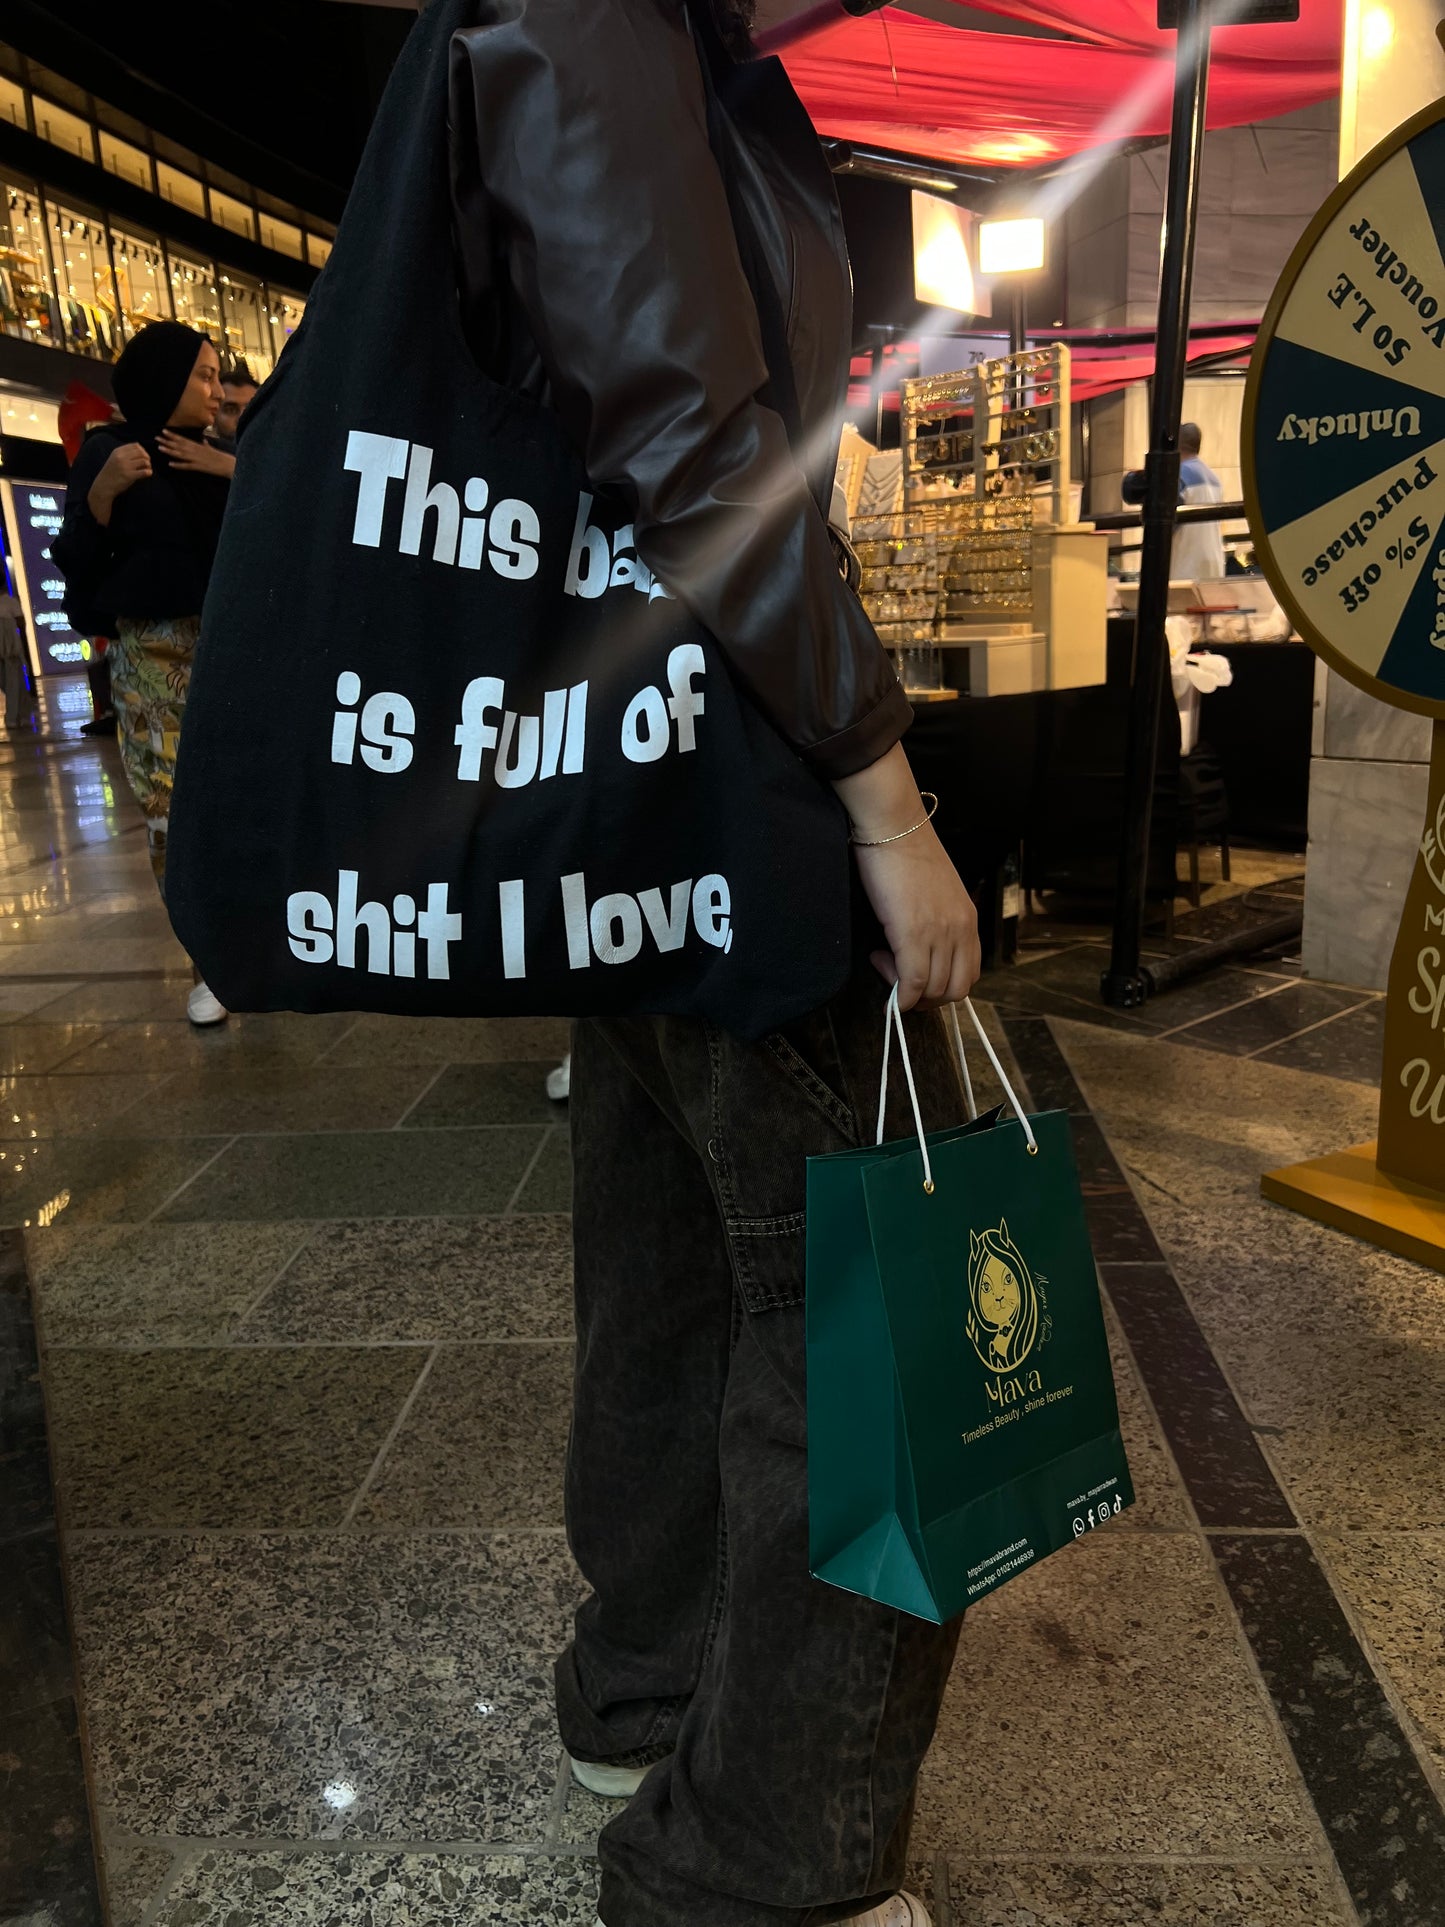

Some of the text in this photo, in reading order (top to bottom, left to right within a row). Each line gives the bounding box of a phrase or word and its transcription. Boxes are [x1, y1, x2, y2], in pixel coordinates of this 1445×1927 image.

[1349, 218, 1445, 349] Voucher
[1373, 325, 1411, 367] 50
[1276, 406, 1421, 445] Unlucky
[344, 430, 677, 604] This ba
[1301, 456, 1438, 587] Purchase
[1385, 515, 1431, 570] 5%
[1338, 563, 1381, 613] off
[331, 644, 706, 788] is full of
[287, 869, 462, 980] shit
[499, 879, 526, 979] I
[961, 1422, 994, 1445] Timeless
[1024, 1396, 1046, 1413] shine
[1046, 1384, 1074, 1404] forever
[984, 1369, 1042, 1413] Mava
